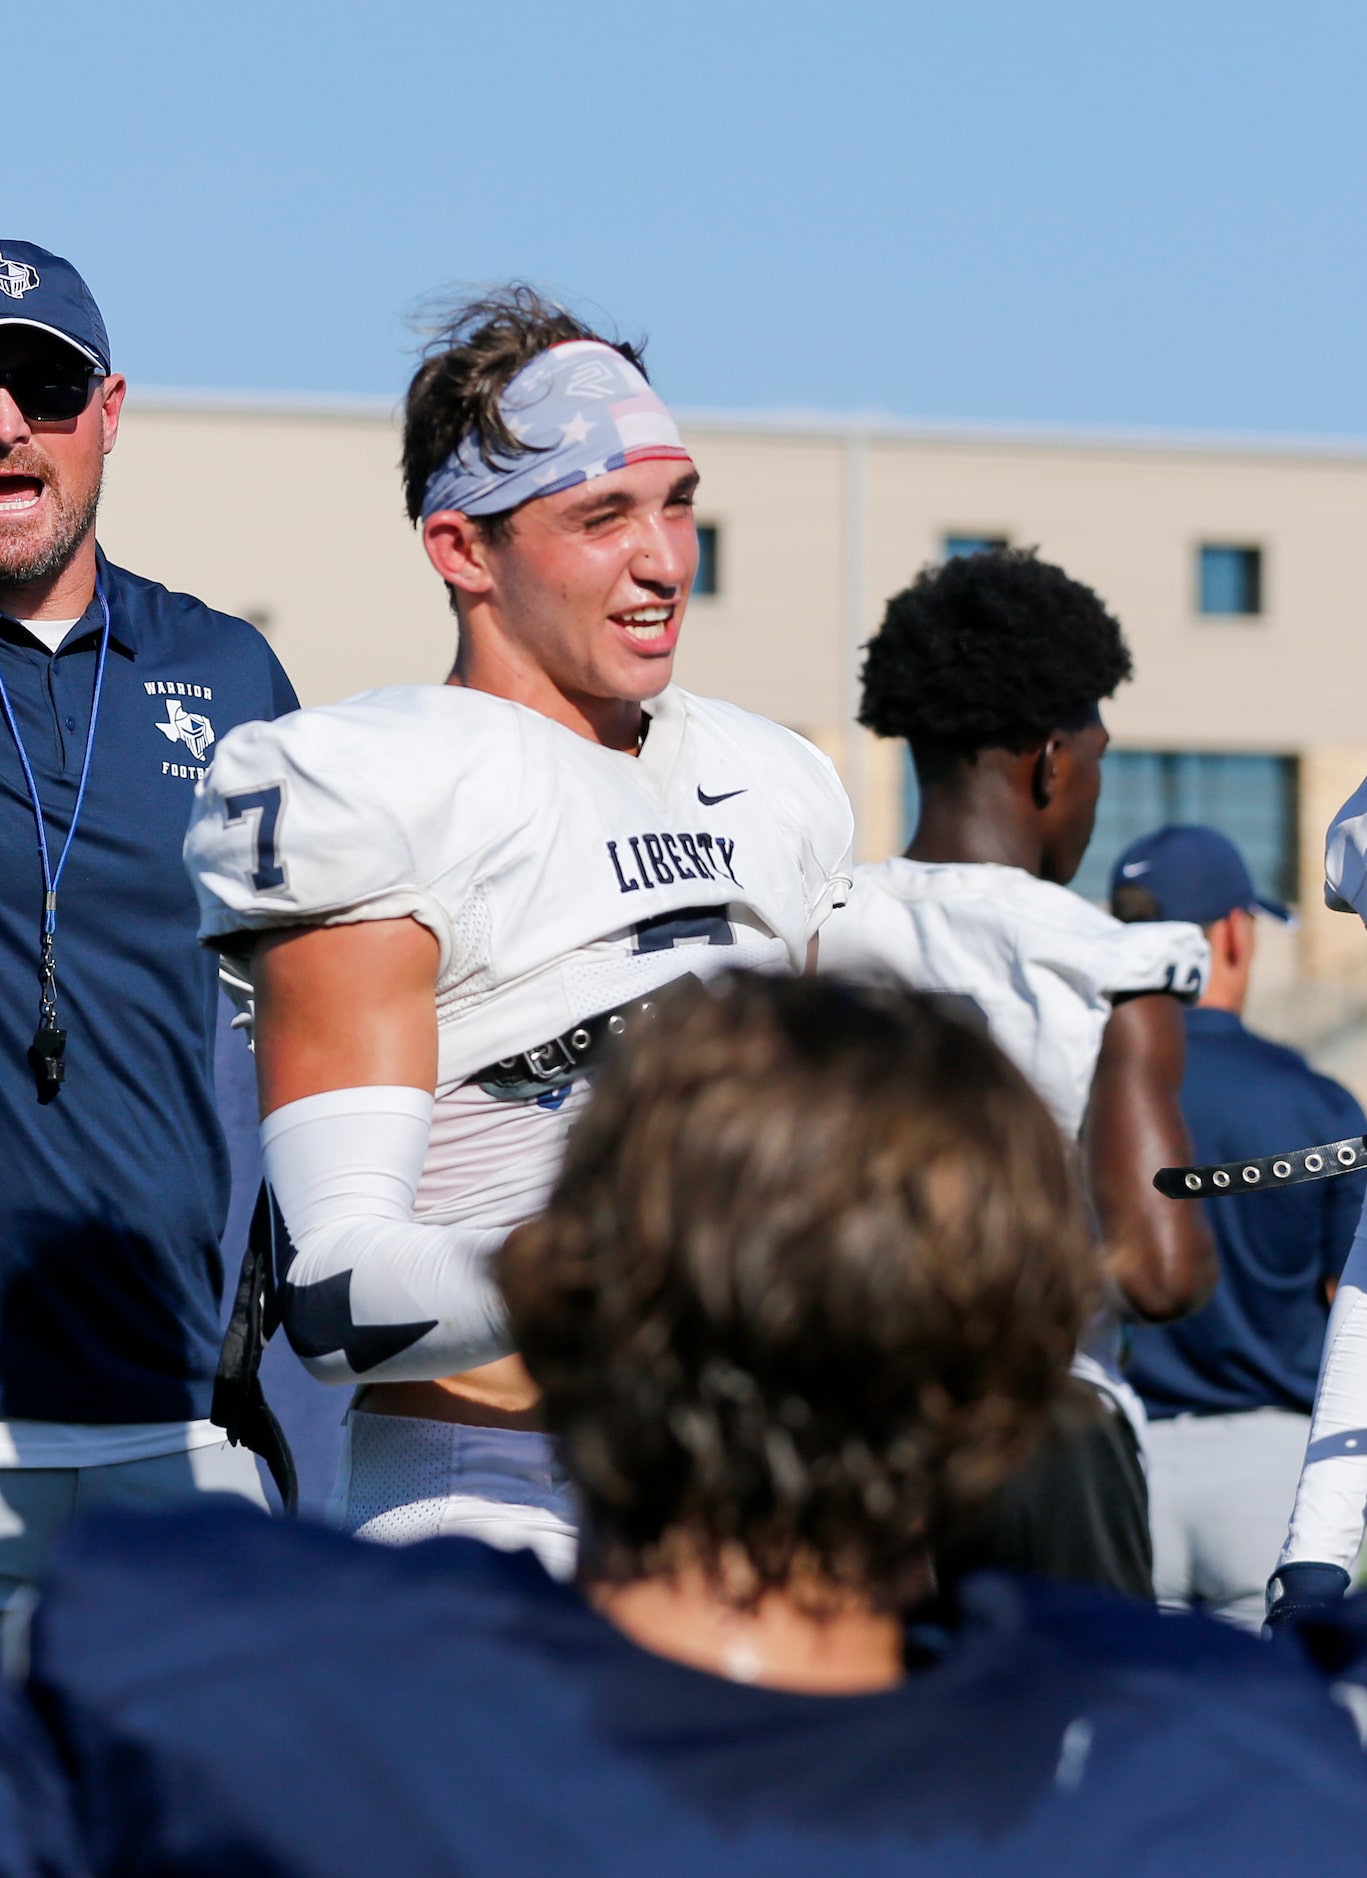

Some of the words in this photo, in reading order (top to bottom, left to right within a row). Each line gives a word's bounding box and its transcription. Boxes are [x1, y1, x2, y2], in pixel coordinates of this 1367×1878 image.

[143, 681, 213, 701] WARRIOR
[161, 761, 209, 780] FOOTB
[224, 781, 289, 894] 7
[606, 832, 744, 893] LIBERTY
